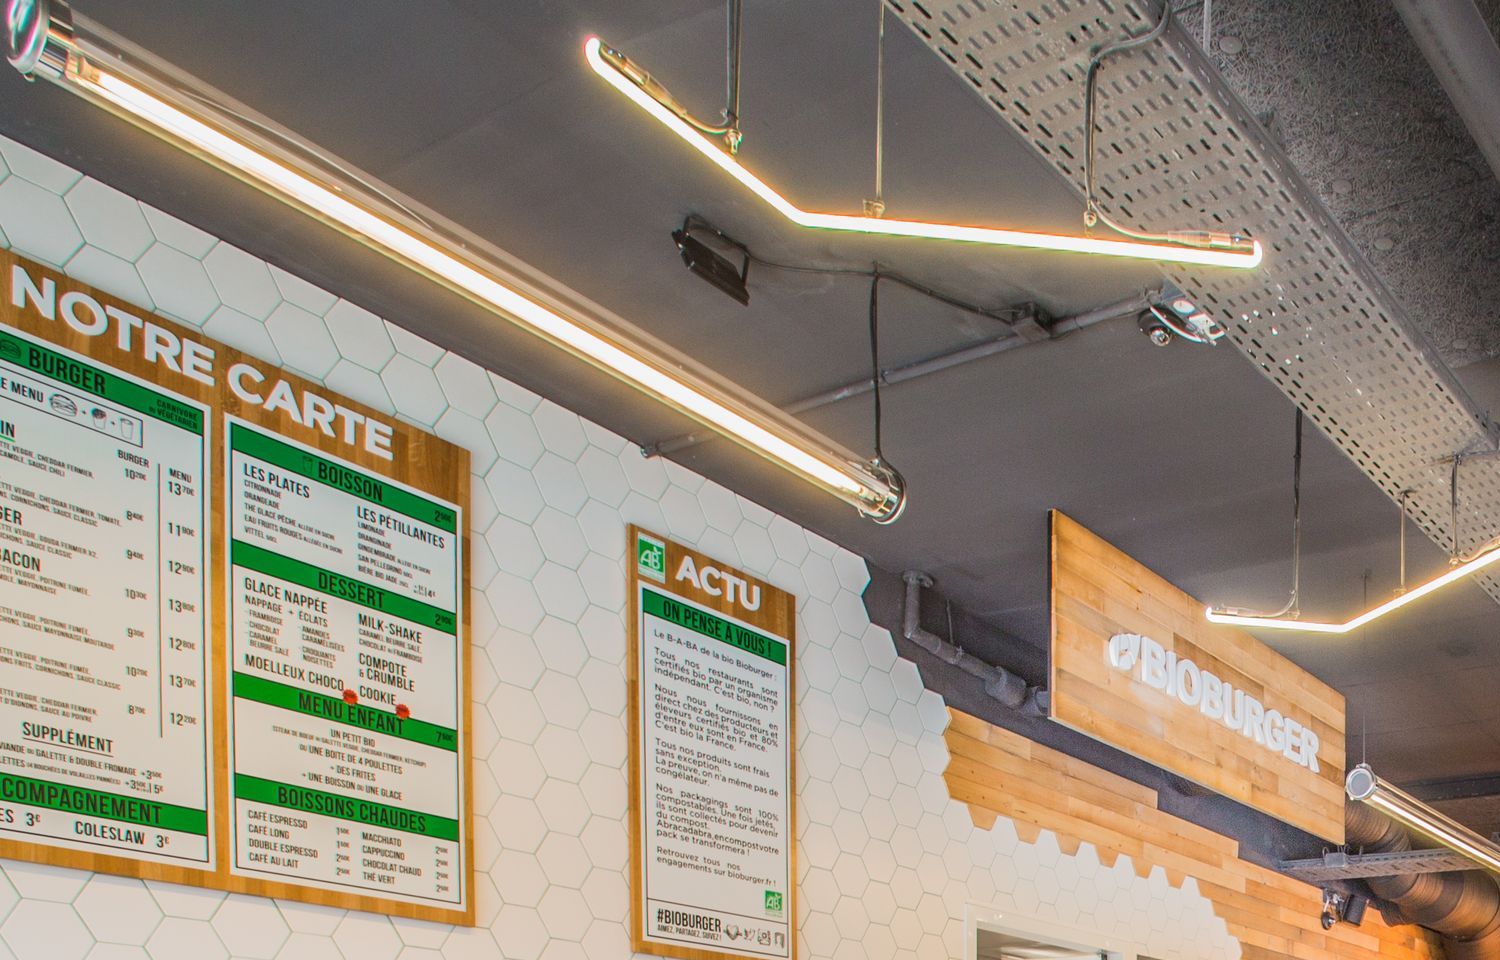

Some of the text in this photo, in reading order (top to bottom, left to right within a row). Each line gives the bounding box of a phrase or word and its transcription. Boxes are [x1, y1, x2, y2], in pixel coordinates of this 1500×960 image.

[11, 264, 394, 462] NOTRE CARTE
[28, 346, 105, 395] BURGER
[11, 380, 43, 403] MENU
[156, 398, 197, 421] CARNIVORE
[117, 448, 149, 468] BURGER
[169, 467, 191, 483] MENU
[243, 462, 309, 499] LES PLATES
[317, 460, 382, 502] BOISSON
[244, 479, 281, 499] CITRONNADE
[244, 525, 264, 539] VITTEL
[279, 526, 302, 540] ROUGES
[357, 505, 444, 549] LES PÉTILLANTES
[357, 520, 385, 537] LIMONADE
[245, 576, 327, 614] GLACE NAPPÉE
[318, 571, 384, 608] DESSERT
[675, 554, 761, 612] ACTU
[245, 594, 282, 614] NAPPAGE
[249, 620, 279, 635] CHOCOLAT
[249, 630, 277, 645] CARAMEL
[358, 612, 422, 644] MILK-SHAKE
[663, 599, 679, 621] ON
[683, 607, 720, 637] PENSE
[725, 622, 732, 642] À
[736, 628, 764, 654] VOUS
[302, 654, 333, 669] NOISETTES
[358, 652, 406, 677] COMPOTE
[654, 628, 772, 681] Le B-A-BA de la bio Bioburger
[245, 653, 343, 691] MOELLEUX CHOCO
[367, 668, 414, 692] CRUMBLE
[654, 646, 777, 698] Tous nos restaurants sont
[654, 655, 777, 708] certifiés bio par un organisme
[359, 685, 396, 706] COOKIE
[654, 665, 710, 692] indépendant.
[714, 686, 733, 699] C'est
[736, 693, 751, 707] bio,
[753, 701, 767, 711] non
[298, 692, 403, 734] MENU ENFANT
[654, 683, 777, 730] Nous nous fournissons en
[1141, 638, 1320, 773] BIOBURGER
[22, 718, 113, 753] SUPPLÉMENT
[330, 728, 375, 747] UN PETIT BIO
[655, 719, 736, 751] C'est bio la France.
[35, 748, 67, 762] GALETTE
[75, 756, 102, 769] DOUBLE
[104, 762, 136, 776] FROMAGE
[309, 744, 402, 774] UNE BOITE DE 4 POULETTES
[655, 737, 769, 777] Tous nos produits sont frais
[336, 765, 375, 782] DES FRITES
[655, 764, 709, 787] congélateur.
[308, 772, 402, 801] UNE BOISSON UNE GLACE
[278, 786, 425, 832] BOISSONS CHAUDES
[655, 783, 778, 821] Nos packagings sont 100%
[248, 807, 307, 829] CAFÉ ESPRESSO
[248, 822, 289, 839] CAFÉ LONG
[75, 820, 144, 845] COLESLAW
[362, 831, 401, 847] MACCHIATO
[248, 838, 317, 858] DOUBLE ESPRESSO
[249, 850, 298, 868] CAFÉ AU LAIT
[362, 845, 404, 860] CAPPUCCINO
[656, 846, 740, 871] Retrouvez tous nos
[362, 858, 421, 876] CHOCOLAT CHAUD
[363, 869, 395, 884] THÉ VERT
[656, 856, 771, 886] engagements sur bioburger.fr
[657, 908, 721, 933] #BIOBURGER
